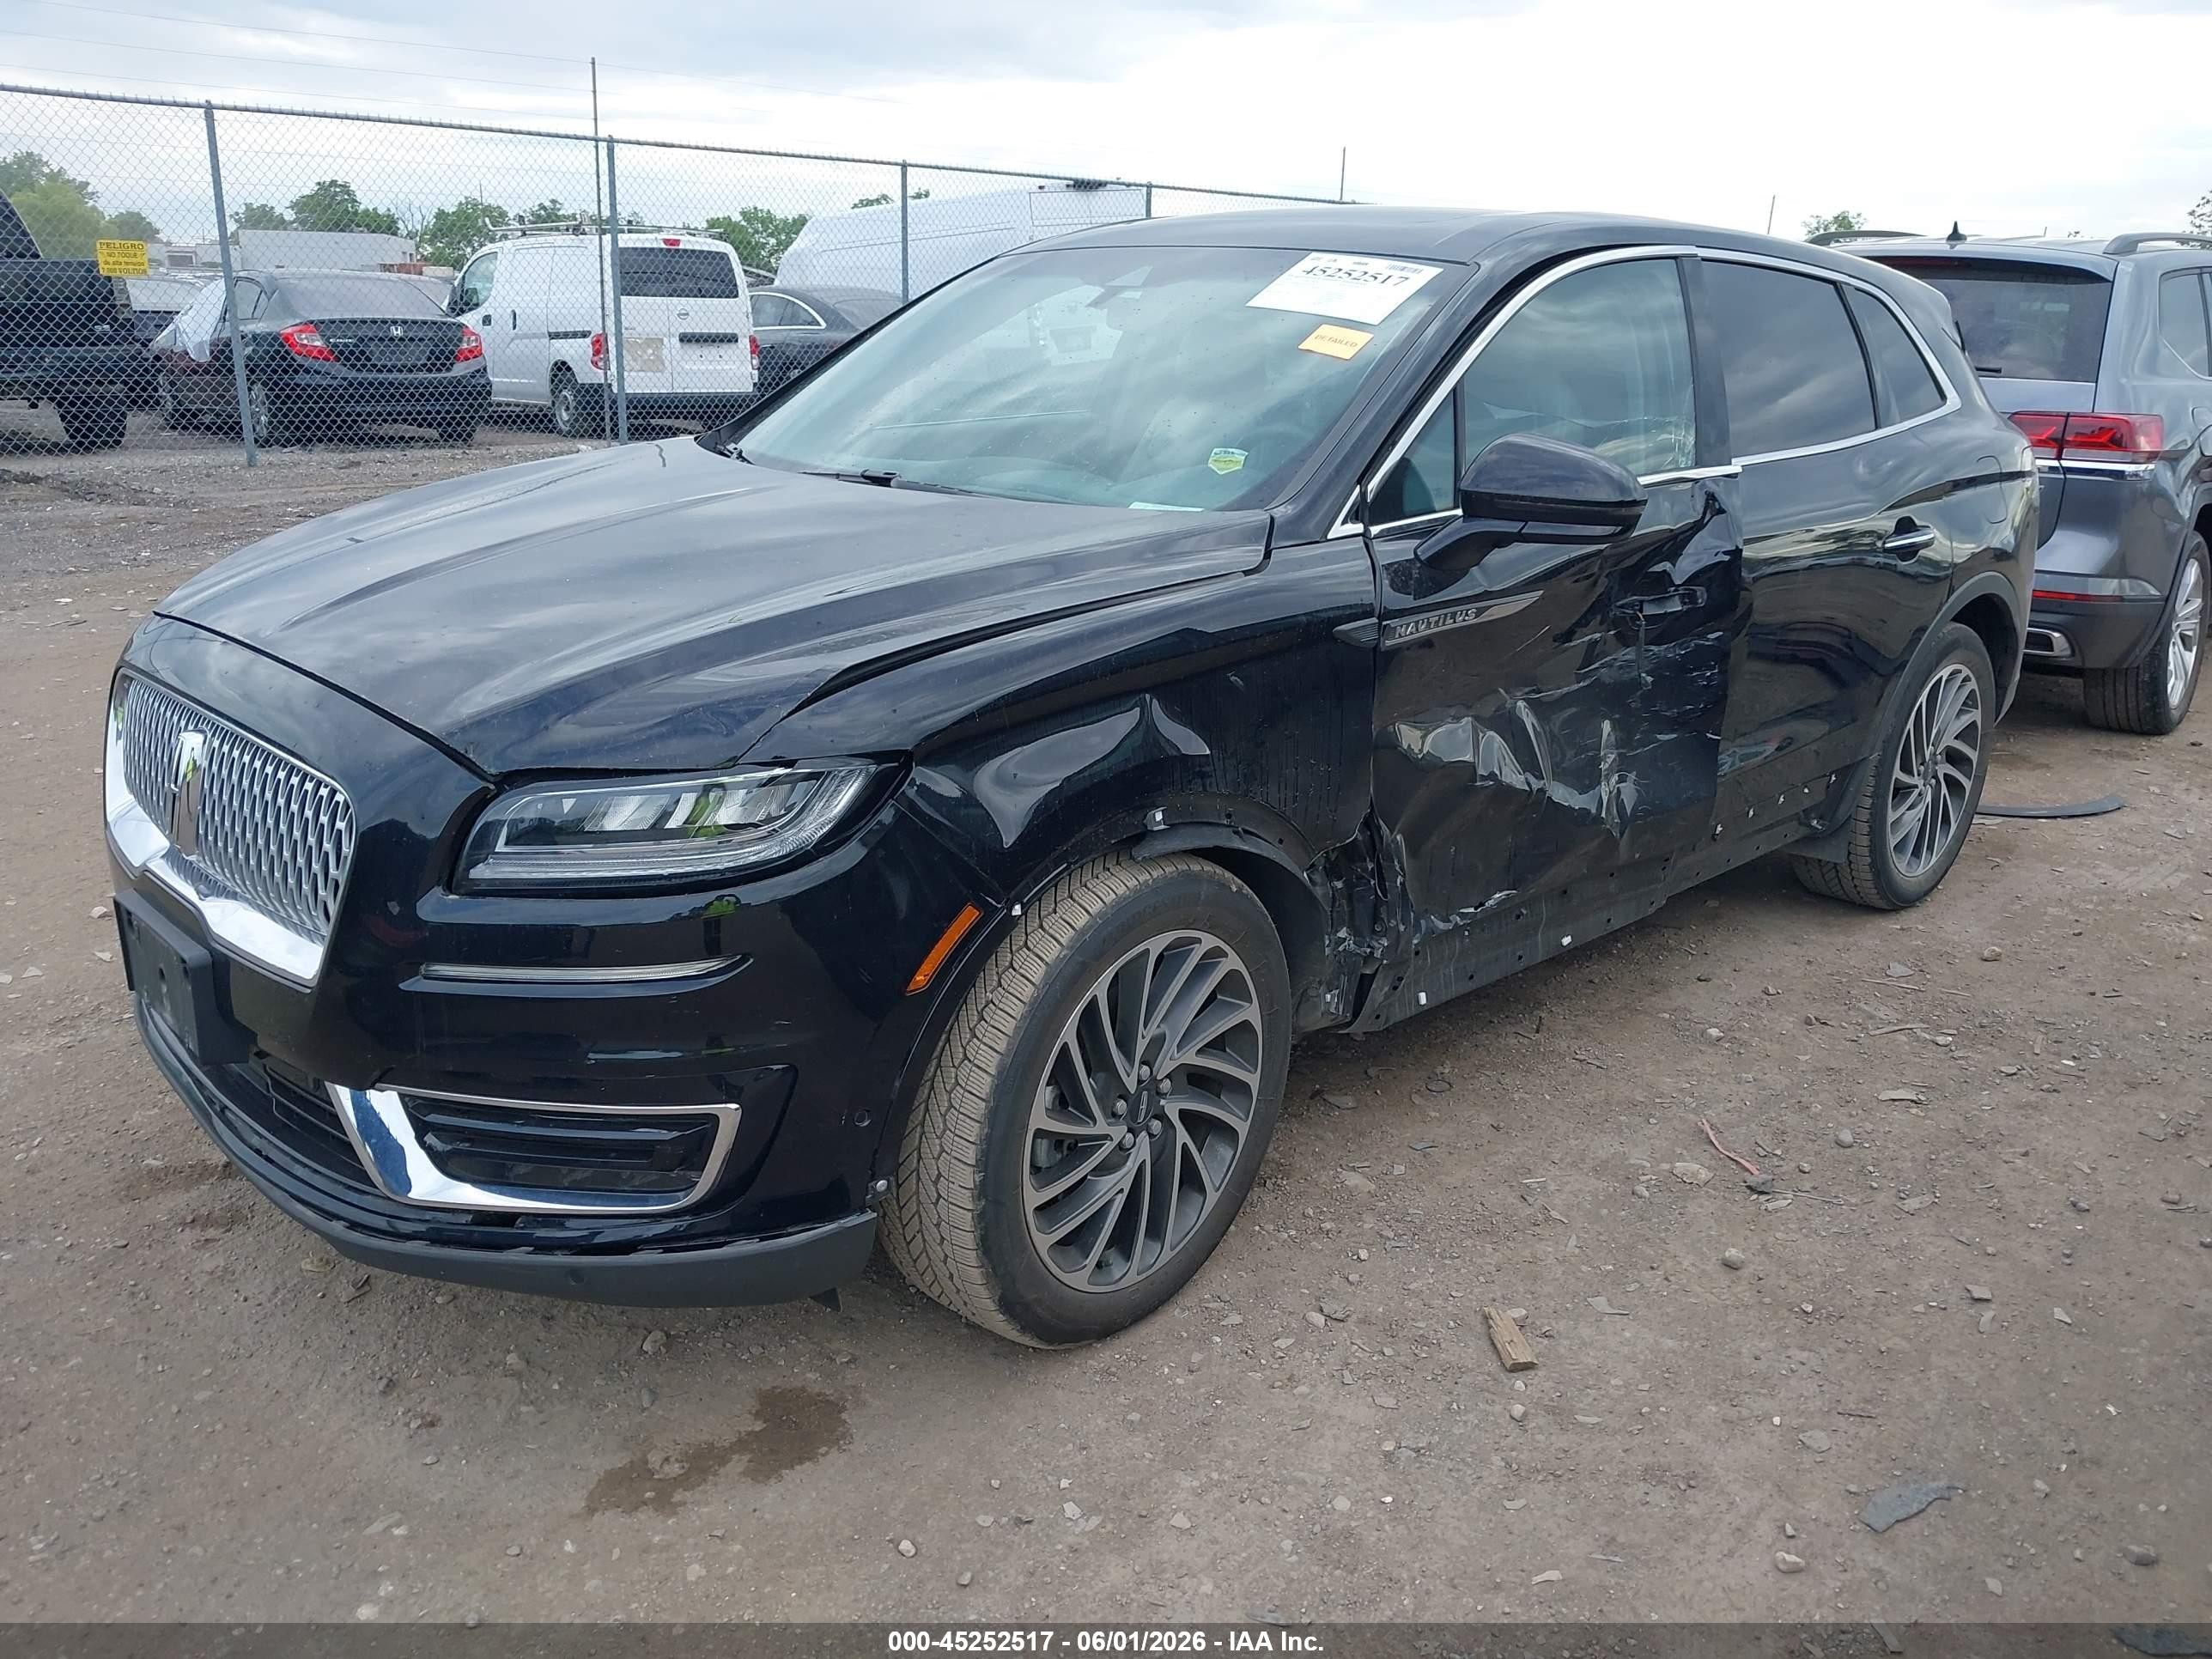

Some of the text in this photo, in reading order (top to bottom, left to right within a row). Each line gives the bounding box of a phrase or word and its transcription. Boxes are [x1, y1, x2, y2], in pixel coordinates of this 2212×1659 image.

[1302, 265, 1411, 286] 45252517
[1314, 334, 1358, 348] DETAILED
[1395, 609, 1477, 638] NAUTILUS
